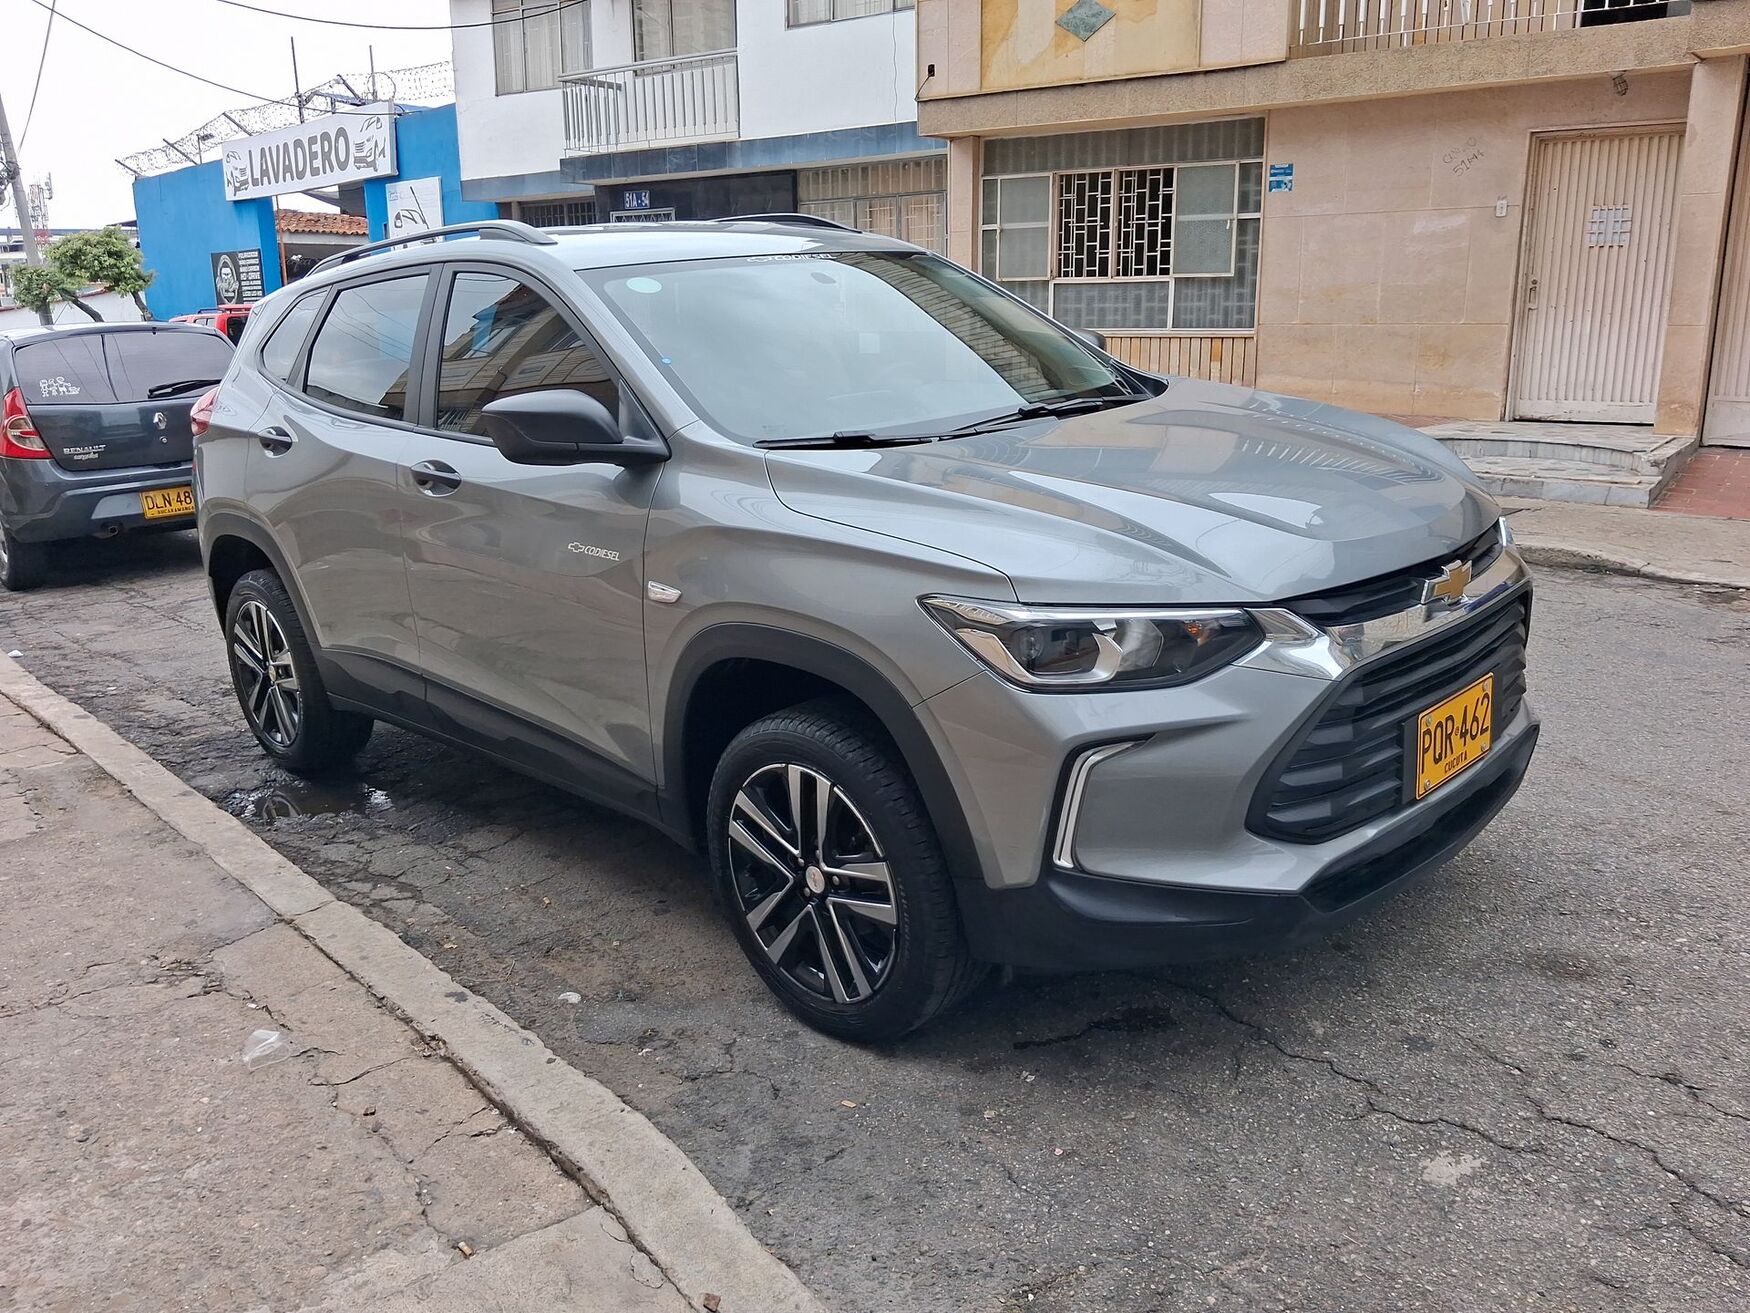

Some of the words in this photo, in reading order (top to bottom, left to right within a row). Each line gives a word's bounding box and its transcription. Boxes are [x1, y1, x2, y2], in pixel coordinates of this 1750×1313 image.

[249, 127, 350, 187] LAVADERO
[63, 444, 106, 455] RENAULT
[145, 492, 173, 510] DLN
[176, 490, 194, 506] 48
[584, 545, 620, 561] CODIESEL
[1421, 714, 1455, 774] PQR
[1459, 692, 1490, 747] 462
[1444, 749, 1468, 774] CUCUTA
